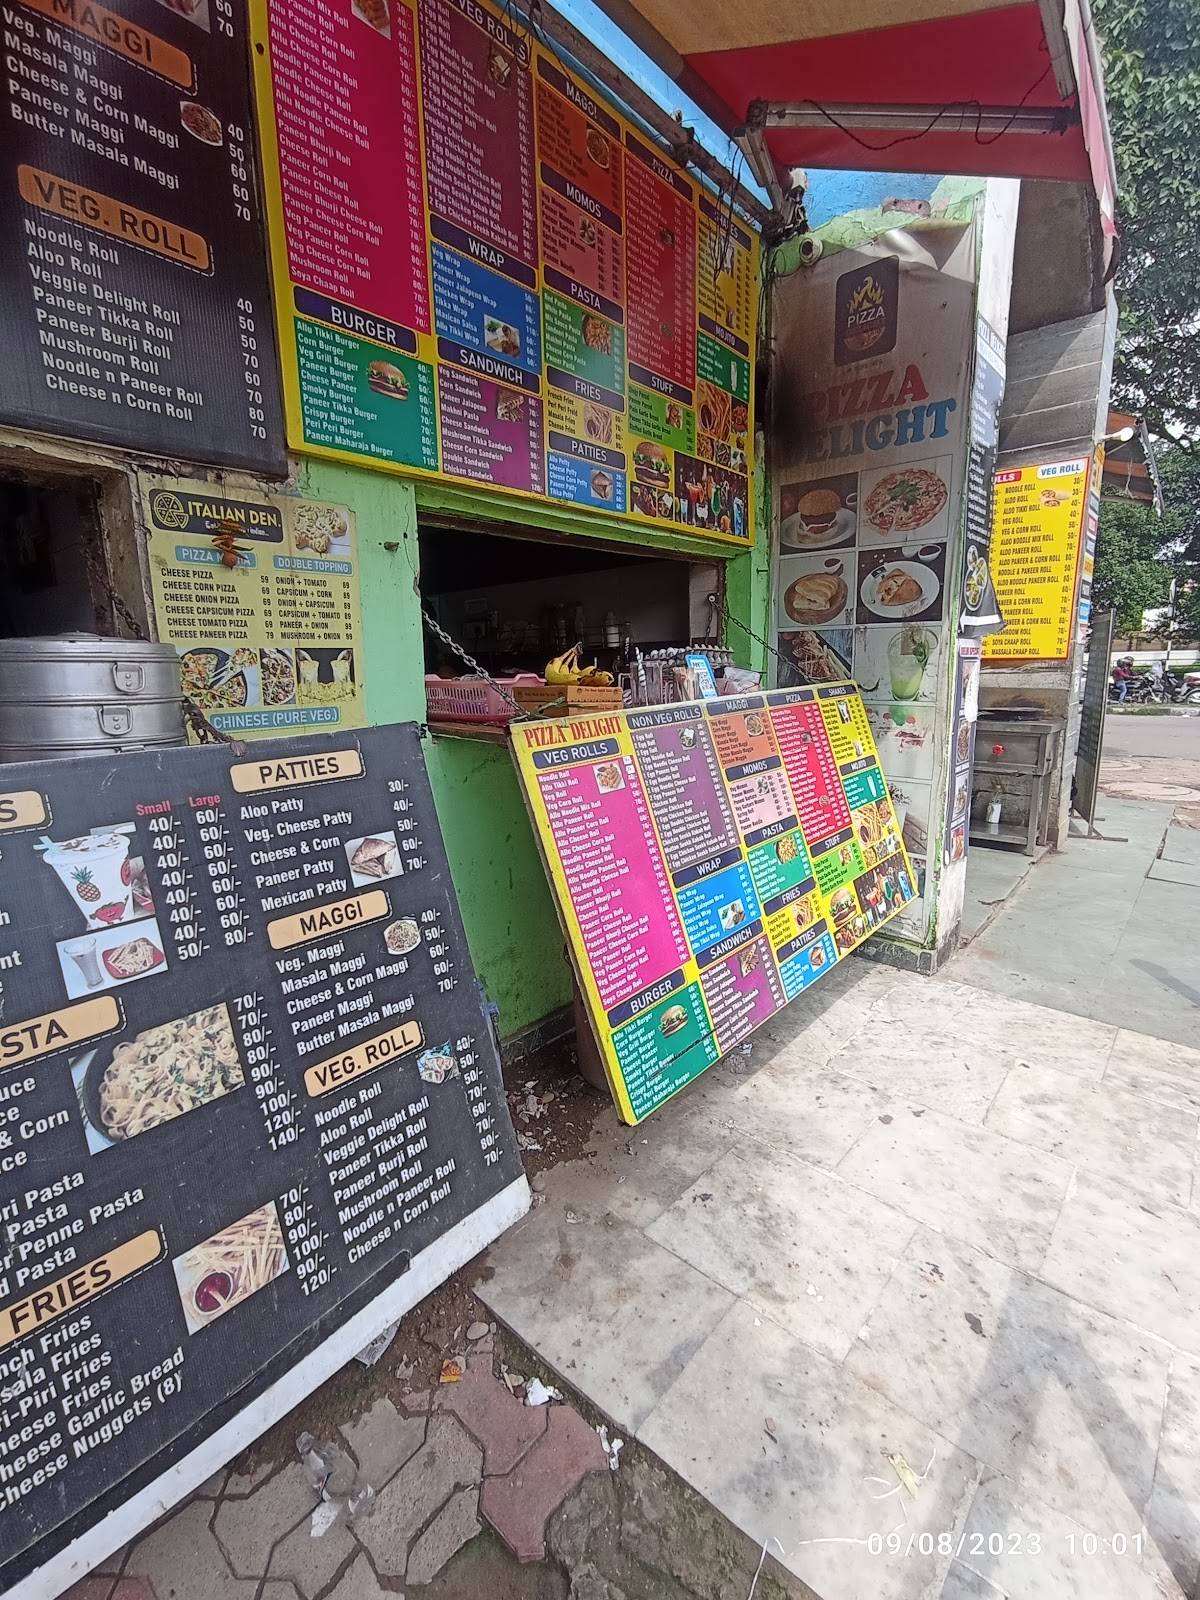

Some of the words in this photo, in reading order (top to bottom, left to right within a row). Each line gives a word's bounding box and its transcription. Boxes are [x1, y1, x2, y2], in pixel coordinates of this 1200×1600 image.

[3, 7, 40, 38] Veg.
[46, 29, 97, 66] Maggi
[5, 32, 68, 73] Masala
[74, 64, 123, 100] Maggi
[7, 56, 69, 95] Cheese
[76, 88, 87, 105] &
[94, 96, 129, 124] Corn
[134, 115, 179, 149] Maggi
[228, 124, 243, 141] 40
[11, 103, 65, 138] Butter
[71, 129, 129, 166] Masala
[135, 155, 179, 189] Maggi
[566, 182, 601, 218] MOMOS
[32, 173, 109, 225] VEG.
[121, 209, 197, 260] ROLL
[234, 203, 250, 221] 70
[25, 219, 83, 252] Noodle
[90, 244, 119, 265] Roll
[468, 238, 505, 267] WRAP
[28, 242, 64, 267] Aloo
[71, 256, 102, 279] Roll
[29, 263, 87, 295] Veggie
[93, 284, 148, 316] Delight
[153, 305, 180, 325] Roll
[571, 282, 601, 309] PASTA
[237, 298, 253, 314] 40
[331, 306, 396, 345] BURGER
[847, 308, 885, 328] PIZZA
[297, 320, 312, 335] Allu
[315, 327, 333, 340] Tikki
[336, 334, 360, 350] Burger
[39, 330, 125, 366] Mushroom
[131, 355, 159, 375] Roll
[439, 366, 450, 377] Veg
[451, 370, 478, 386] Sandwich
[460, 350, 523, 385] SANDWICH
[245, 371, 260, 387] 60
[575, 380, 601, 400] FRIES
[651, 375, 674, 395] STUFF
[46, 373, 106, 401] Cheese
[112, 391, 121, 403] n
[127, 395, 161, 414] Corn
[166, 402, 193, 422] Roll
[303, 394, 330, 408] Paneer
[333, 401, 352, 415] Tikka
[354, 407, 378, 421] Burger
[304, 406, 327, 420] Crispy
[330, 412, 355, 426] Burger
[251, 424, 266, 440] 70
[306, 429, 332, 443] Paneer
[335, 437, 369, 451] Maharaja
[371, 444, 393, 456] Burger
[572, 441, 607, 461] PATTIES
[444, 464, 466, 476] Chicken
[468, 469, 493, 481] Sandwich
[1041, 467, 1057, 476] VEG
[1060, 464, 1080, 473] ROLL
[187, 502, 246, 525] ITALIAN
[250, 511, 281, 528] DEN.
[182, 549, 213, 562] PIZZA
[278, 558, 313, 571] DOUBLE
[314, 560, 349, 573] TOPPING
[161, 568, 190, 579] CHEESE
[192, 570, 214, 580] PIZZA
[275, 577, 295, 586] ONION
[304, 579, 327, 588] TOMATO
[163, 581, 192, 591] CHEESE
[194, 583, 213, 592] CORN
[215, 584, 236, 593] PIZZA
[164, 593, 193, 603] CHEESE
[195, 594, 217, 604] ONION
[219, 596, 240, 605] PIZZA
[166, 606, 194, 615] CHEESE
[197, 607, 234, 616] CAPSICUM
[236, 608, 255, 617] PIZZA
[169, 630, 198, 639] CHEESE
[199, 630, 226, 639] PANEER
[228, 631, 248, 639] PIZZA
[725, 702, 748, 712] MAGGI
[786, 694, 801, 703] PIZZA
[213, 714, 269, 730] CHINESE
[273, 711, 307, 727] (PURE
[310, 708, 338, 722] VEG.)
[631, 716, 654, 728] NON
[655, 712, 673, 724] VEG
[674, 708, 700, 721] ROLLS
[523, 722, 567, 748] PIZZA
[569, 716, 623, 735] DELIGHT
[543, 751, 571, 764] VEG
[572, 743, 609, 758] ROLLS
[259, 756, 340, 785] PATTIES
[742, 760, 767, 774] MOMOS
[388, 780, 409, 794] 30/-
[136, 800, 171, 817] Small
[189, 793, 221, 808] Large
[240, 805, 269, 820] Aloo
[271, 798, 305, 815] Patty
[149, 816, 182, 832] 40/-
[196, 809, 226, 825] 60/-
[244, 826, 275, 844] Veg.
[277, 817, 321, 837] Cheese
[323, 811, 353, 829] Patty
[762, 824, 784, 838] PASTA
[250, 847, 297, 867] Cheese
[300, 841, 310, 854] &
[313, 836, 340, 852] Corn
[825, 836, 841, 849] STUFF
[256, 868, 301, 889] Paneer
[303, 858, 335, 879] Patty
[696, 858, 722, 875] WRAP
[261, 883, 315, 912] Mexican
[317, 877, 347, 898] Patty
[782, 889, 800, 904] FRIES
[299, 900, 364, 936] MAGGI
[710, 929, 752, 959] SANDWICH
[791, 929, 815, 951] PATTIES
[281, 967, 328, 995] Masala
[331, 953, 366, 977] Maggi
[630, 979, 673, 1013] BURGER
[314, 1056, 362, 1088] VEG.
[365, 1029, 414, 1065] ROLL
[337, 1176, 399, 1225] Mushroom
[401, 1160, 423, 1184] Roll
[18, 1215, 84, 1262] Penne
[90, 1188, 145, 1225] Pasta
[9, 1259, 113, 1335] FRIES
[68, 1388, 126, 1435] Garlic
[130, 1347, 185, 1394] Bread
[73, 1394, 152, 1458] Nuggets
[157, 1371, 183, 1404] (8)
